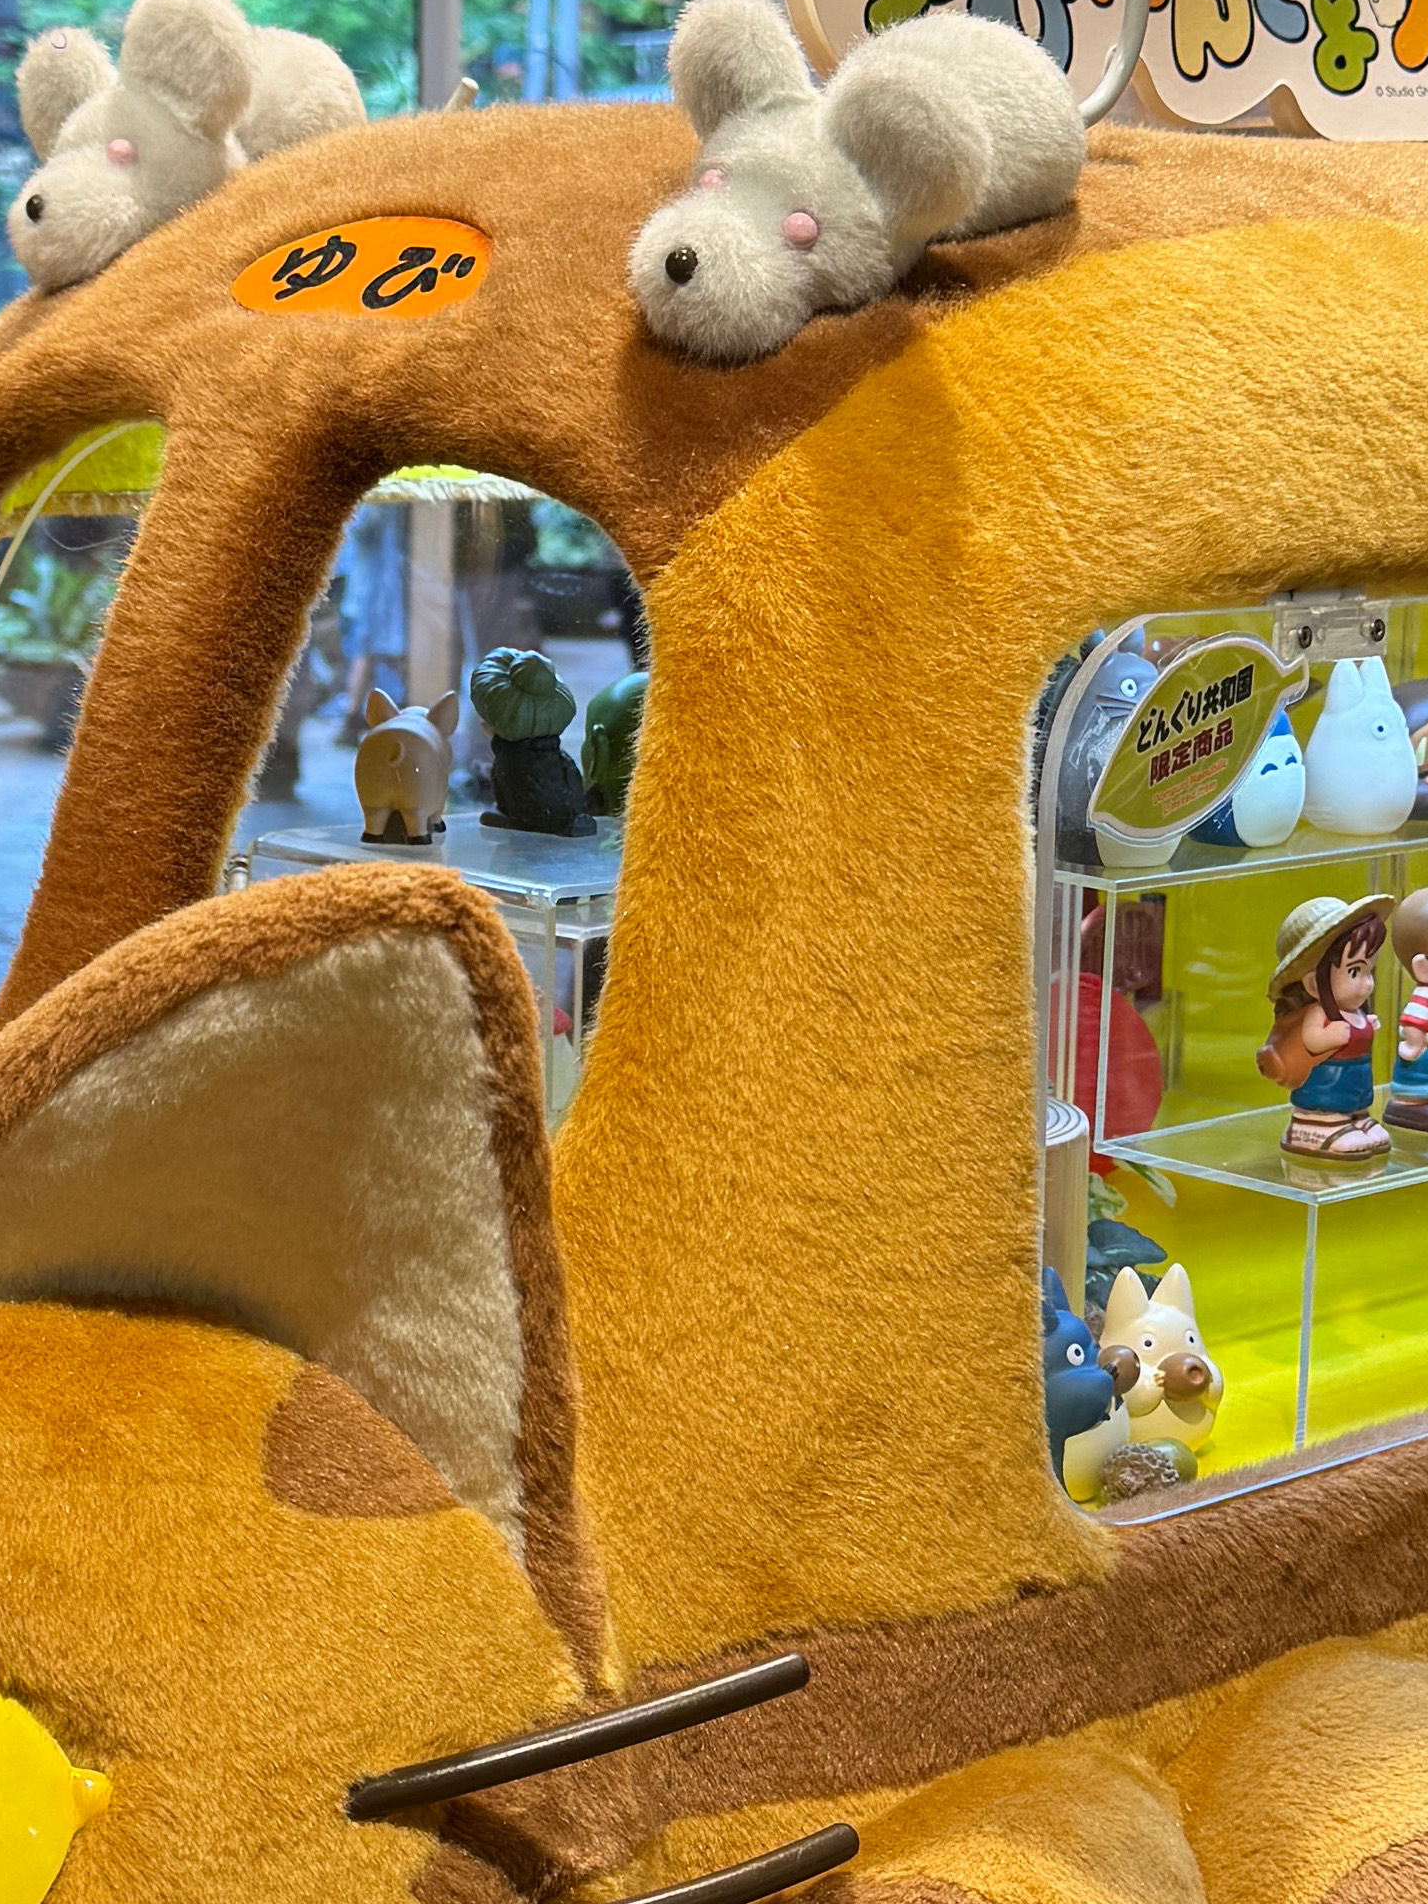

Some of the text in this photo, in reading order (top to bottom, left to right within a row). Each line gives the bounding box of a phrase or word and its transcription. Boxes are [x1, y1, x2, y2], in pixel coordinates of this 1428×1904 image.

[271, 235, 476, 310] ゆび
[1136, 663, 1255, 753] どんぐり共和国
[1149, 716, 1234, 787] 限定商品
